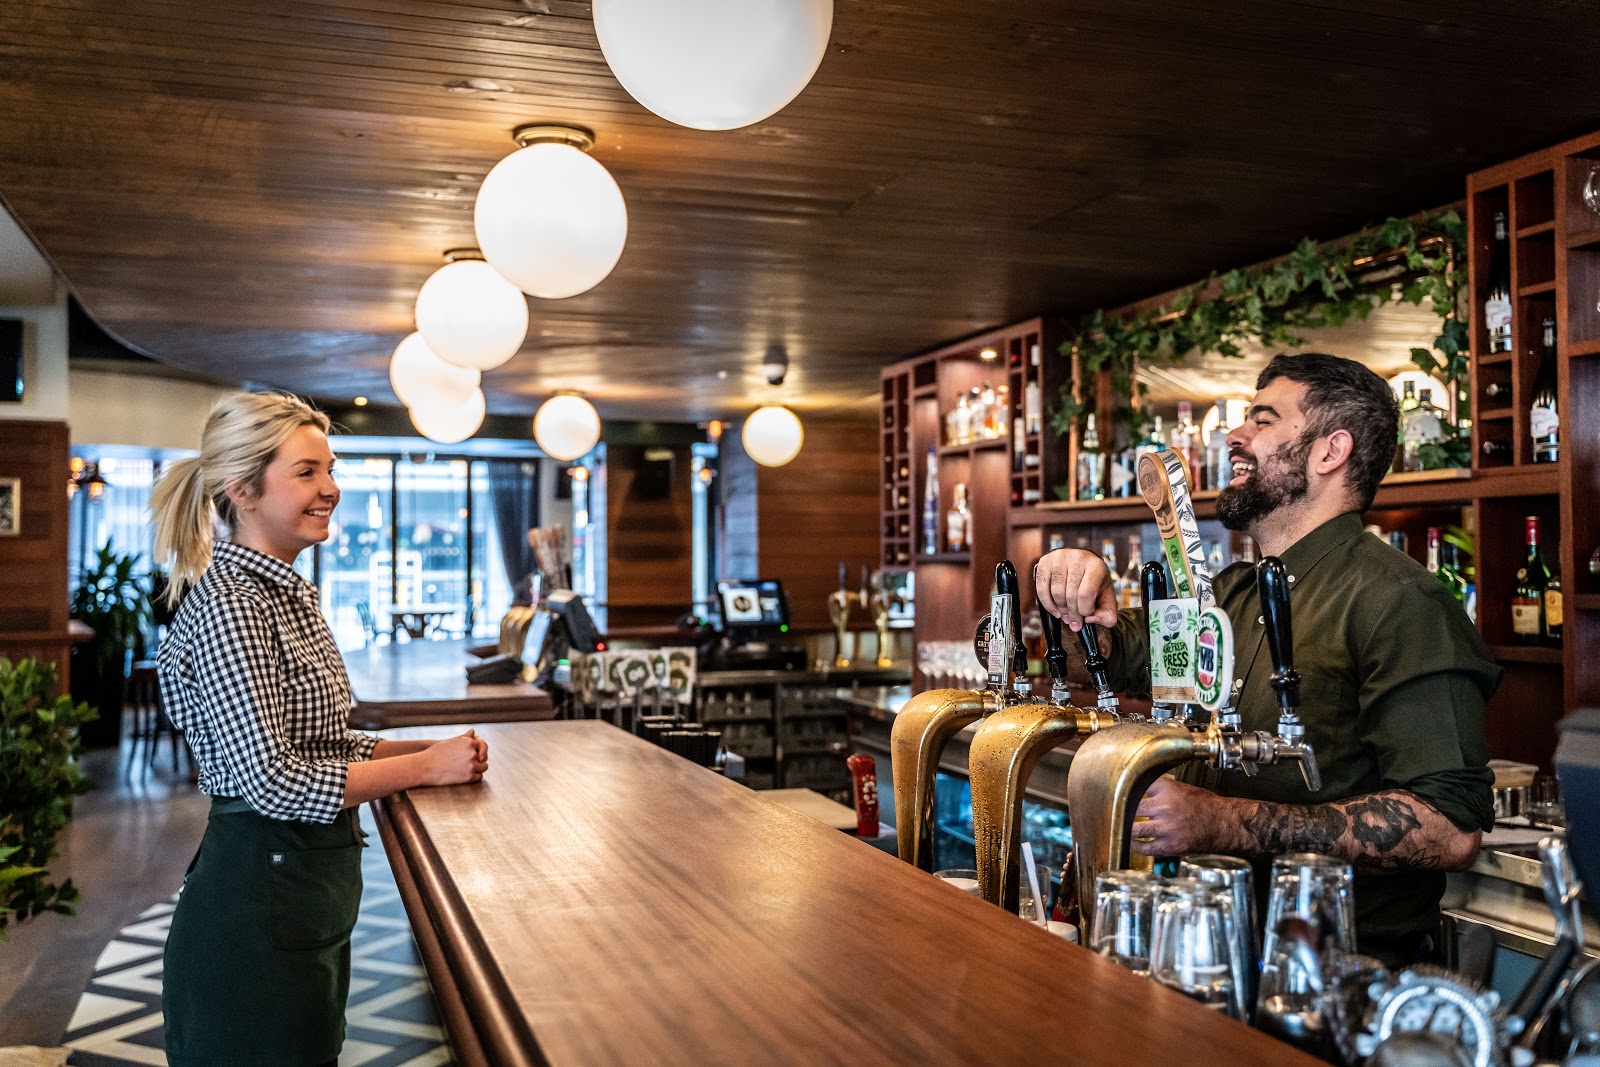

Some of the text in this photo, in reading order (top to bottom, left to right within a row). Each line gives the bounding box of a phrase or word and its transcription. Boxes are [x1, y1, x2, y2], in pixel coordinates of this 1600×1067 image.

[1163, 651, 1189, 668] PRESS
[1200, 646, 1214, 672] VB
[1166, 666, 1186, 677] CIDER
